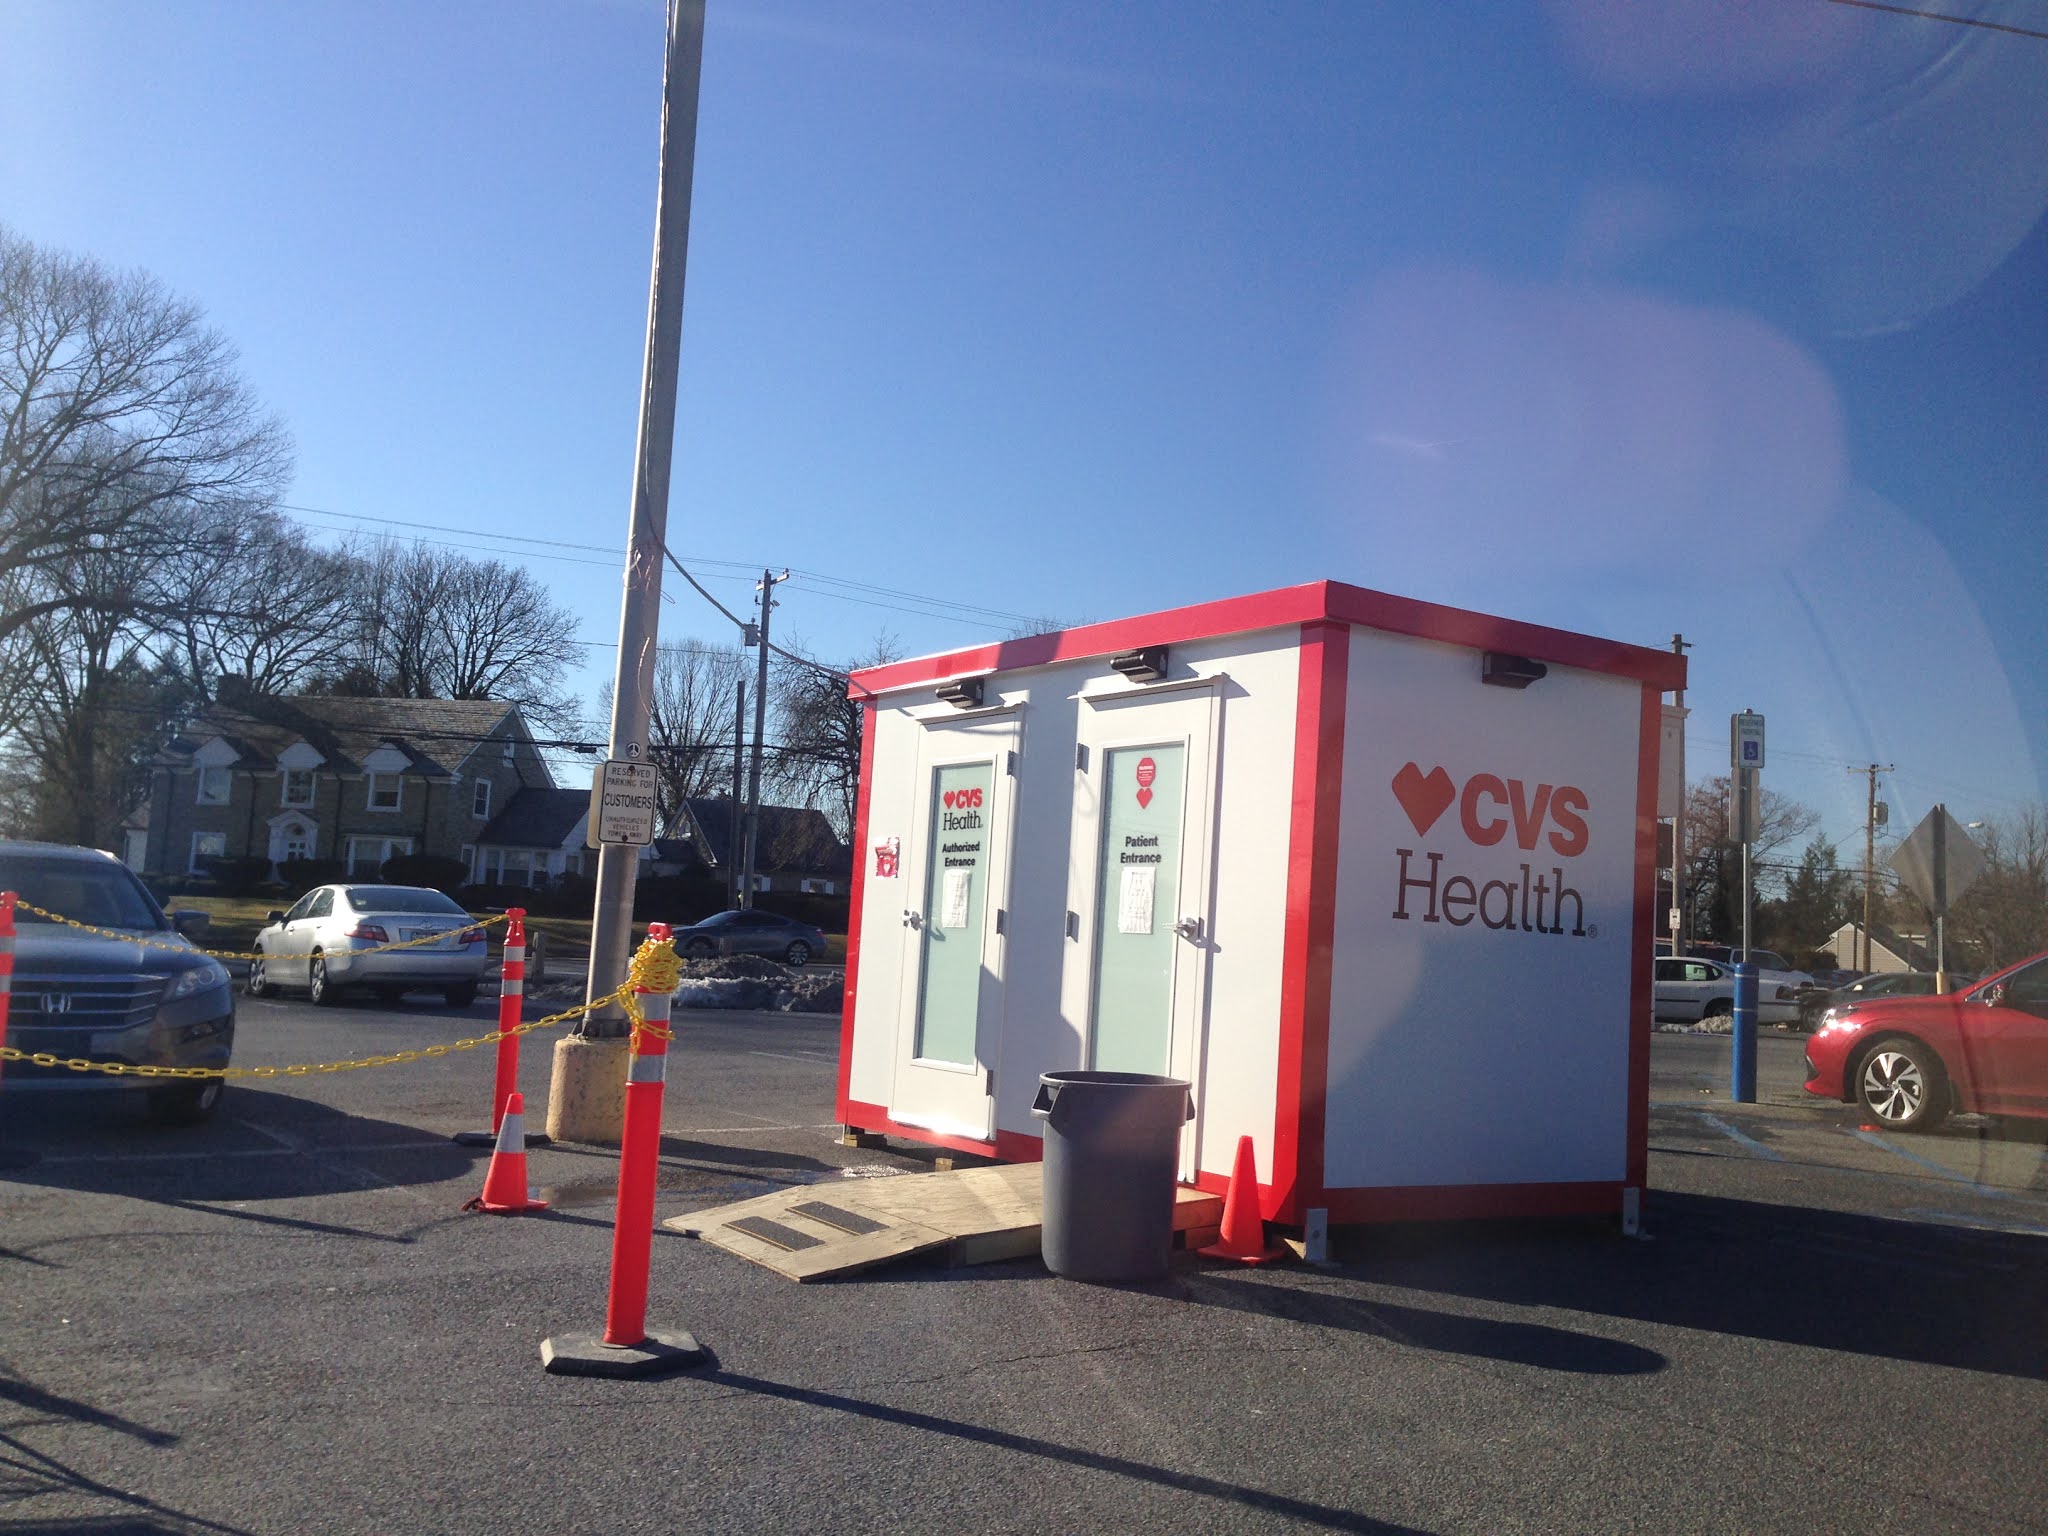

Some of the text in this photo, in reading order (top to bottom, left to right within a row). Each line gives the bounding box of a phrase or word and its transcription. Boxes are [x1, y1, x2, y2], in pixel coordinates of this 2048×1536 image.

[612, 767, 651, 778] RESERVED
[607, 778, 654, 789] PARKING FOR
[605, 793, 653, 809] CUSTOMERS
[955, 788, 983, 809] CVS
[606, 816, 648, 825] UNAUTHORIZED
[943, 811, 982, 830] Health
[1460, 773, 1589, 857] CVS
[1125, 835, 1159, 847] Patient
[942, 842, 980, 853] Authorized
[944, 857, 976, 867] Entrance
[1120, 852, 1162, 864] Entrance
